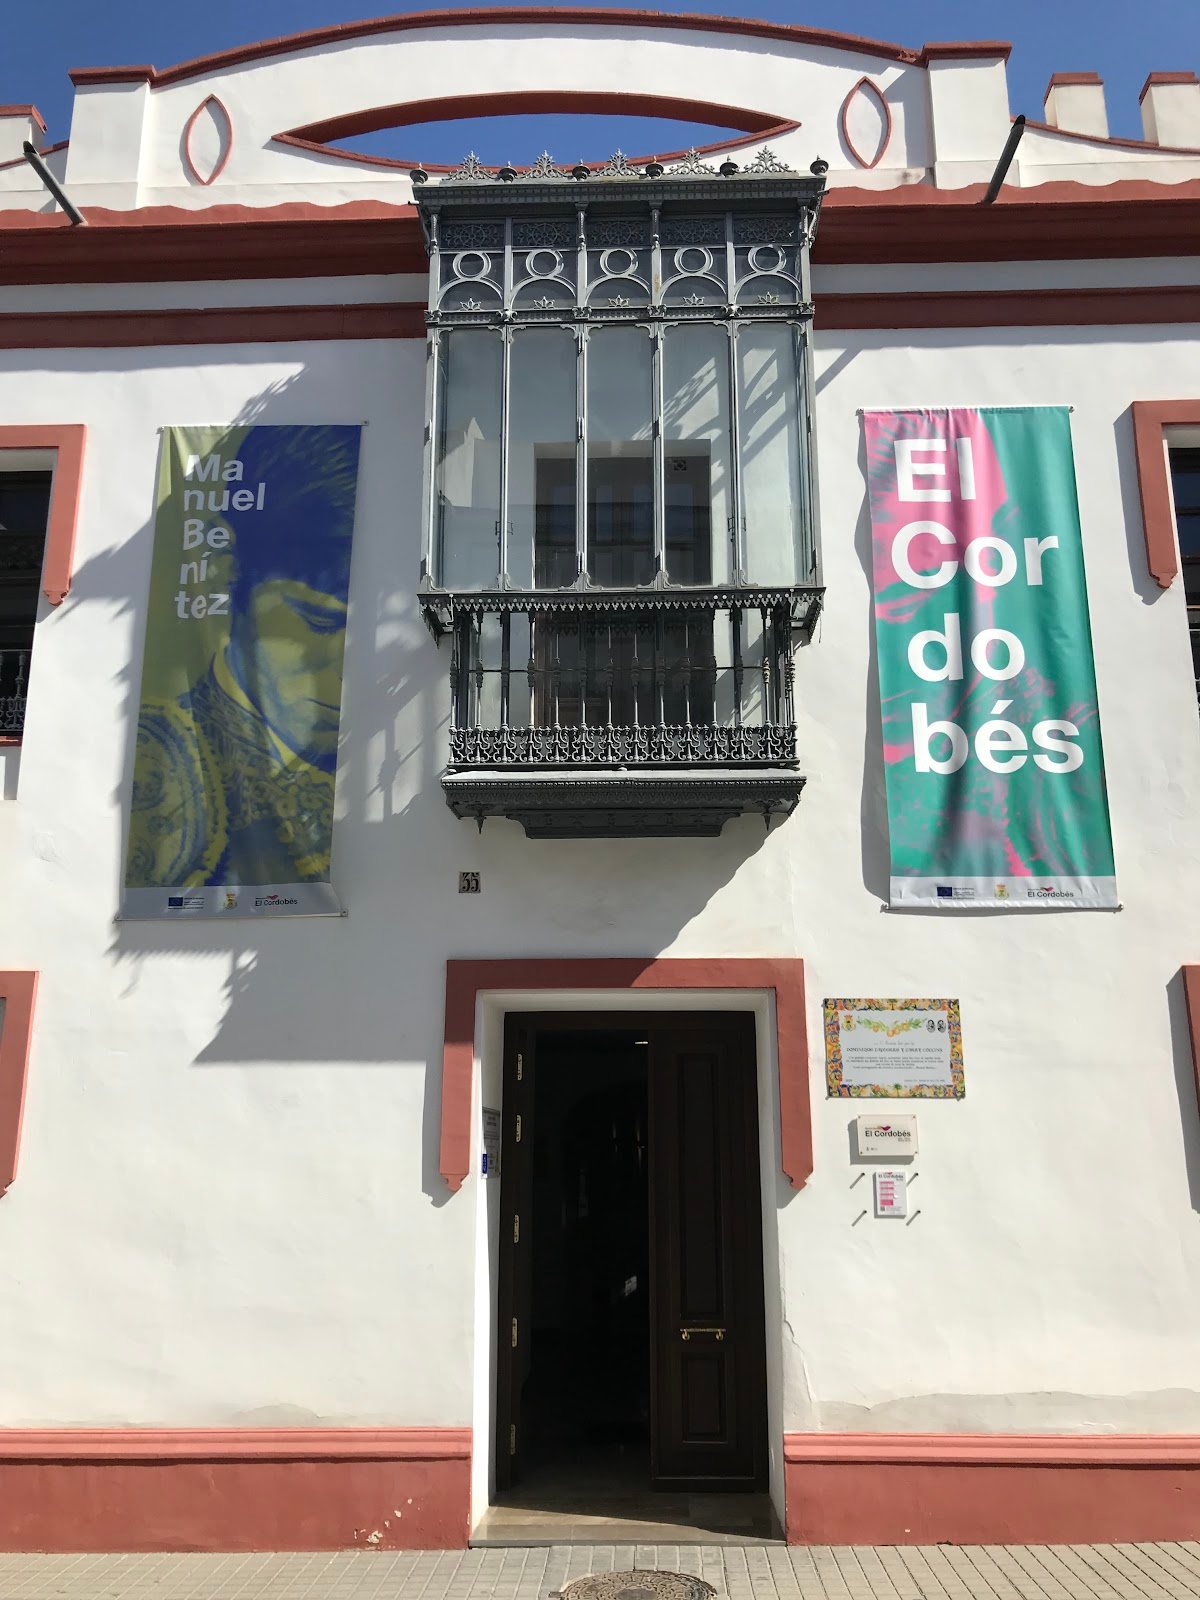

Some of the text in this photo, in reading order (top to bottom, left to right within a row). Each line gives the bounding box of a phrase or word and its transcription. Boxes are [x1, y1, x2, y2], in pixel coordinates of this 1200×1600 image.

[185, 454, 244, 482] Ma
[894, 437, 976, 502] El
[184, 482, 266, 512] nuel
[183, 518, 230, 550] Be
[180, 551, 212, 585] ní
[891, 520, 1060, 589] Cor
[174, 591, 229, 619] tez
[907, 612, 1025, 682] do
[911, 700, 1084, 774] bés
[874, 1129, 911, 1137] Cordobés
